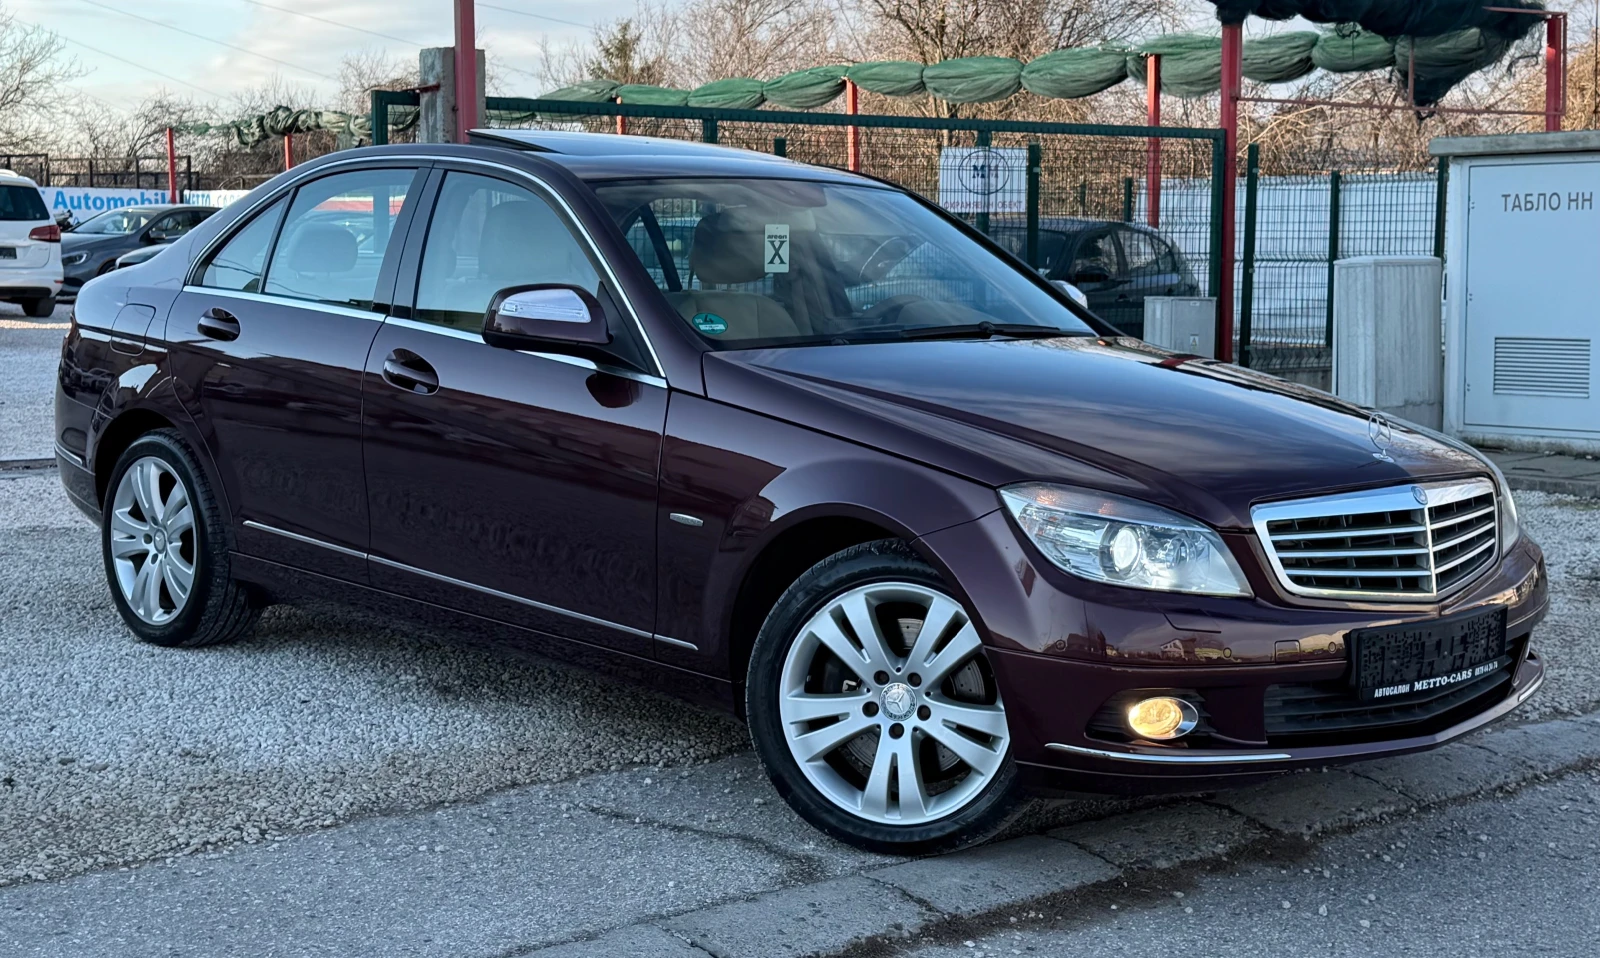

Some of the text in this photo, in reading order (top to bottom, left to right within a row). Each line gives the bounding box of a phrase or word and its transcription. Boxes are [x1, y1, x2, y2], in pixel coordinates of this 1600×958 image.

[53, 190, 178, 210] Automobil
[1501, 191, 1593, 212] ТАБЛО НН
[767, 240, 788, 265] X
[1374, 683, 1410, 698] АВТОСАЛОН
[1414, 668, 1473, 692] METTO-CARS
